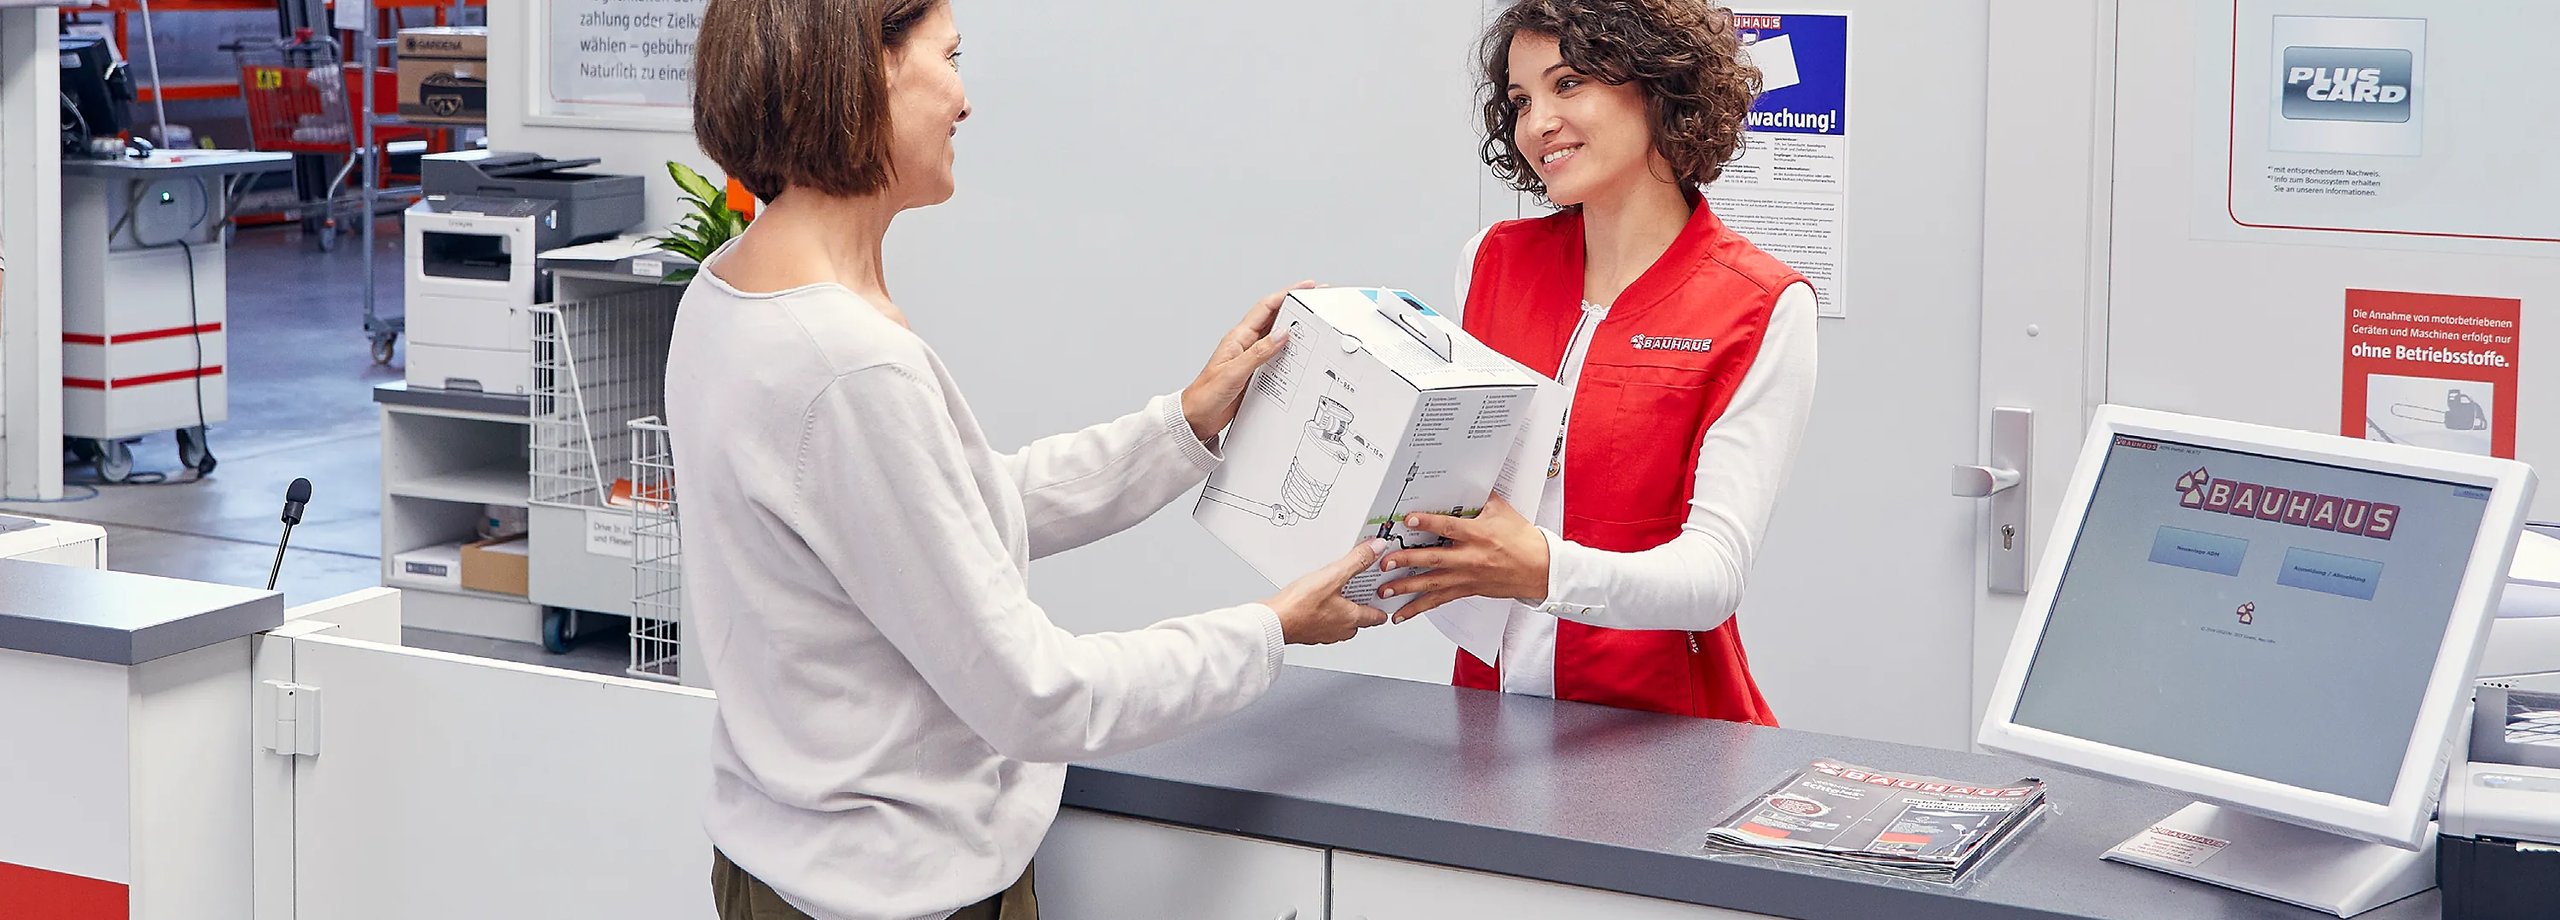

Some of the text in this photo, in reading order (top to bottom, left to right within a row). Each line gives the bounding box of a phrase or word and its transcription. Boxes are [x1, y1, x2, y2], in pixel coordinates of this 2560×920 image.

[580, 11, 630, 31] zahlung
[634, 13, 663, 29] oder
[580, 36, 626, 53] wählen
[642, 38, 695, 57] gebühre
[641, 69, 655, 80] zu
[2288, 67, 2381, 86] PLUS
[2307, 82, 2407, 104] CARD
[1748, 108, 1836, 133] wachung!
[2287, 167, 2344, 176] entsprechendem
[2346, 169, 2380, 178] Nachweis.
[2305, 177, 2350, 186] Bonussystem
[2351, 179, 2381, 187] erhalten
[2325, 188, 2376, 196] Informationen.
[2353, 309, 2513, 328] Die Annahme von motorbetriebenen
[2352, 324, 2512, 345] Geräten und Maschinen erfolgt nur
[1643, 338, 1712, 352] BAUHAUS
[2352, 342, 2510, 368] ohne Betriebsstoffe.
[2121, 439, 2158, 451] BAUHAUS
[2208, 483, 2394, 533] BAUHAUS
[594, 522, 611, 532] Drive
[1842, 771, 2033, 796] BAUHAUS
